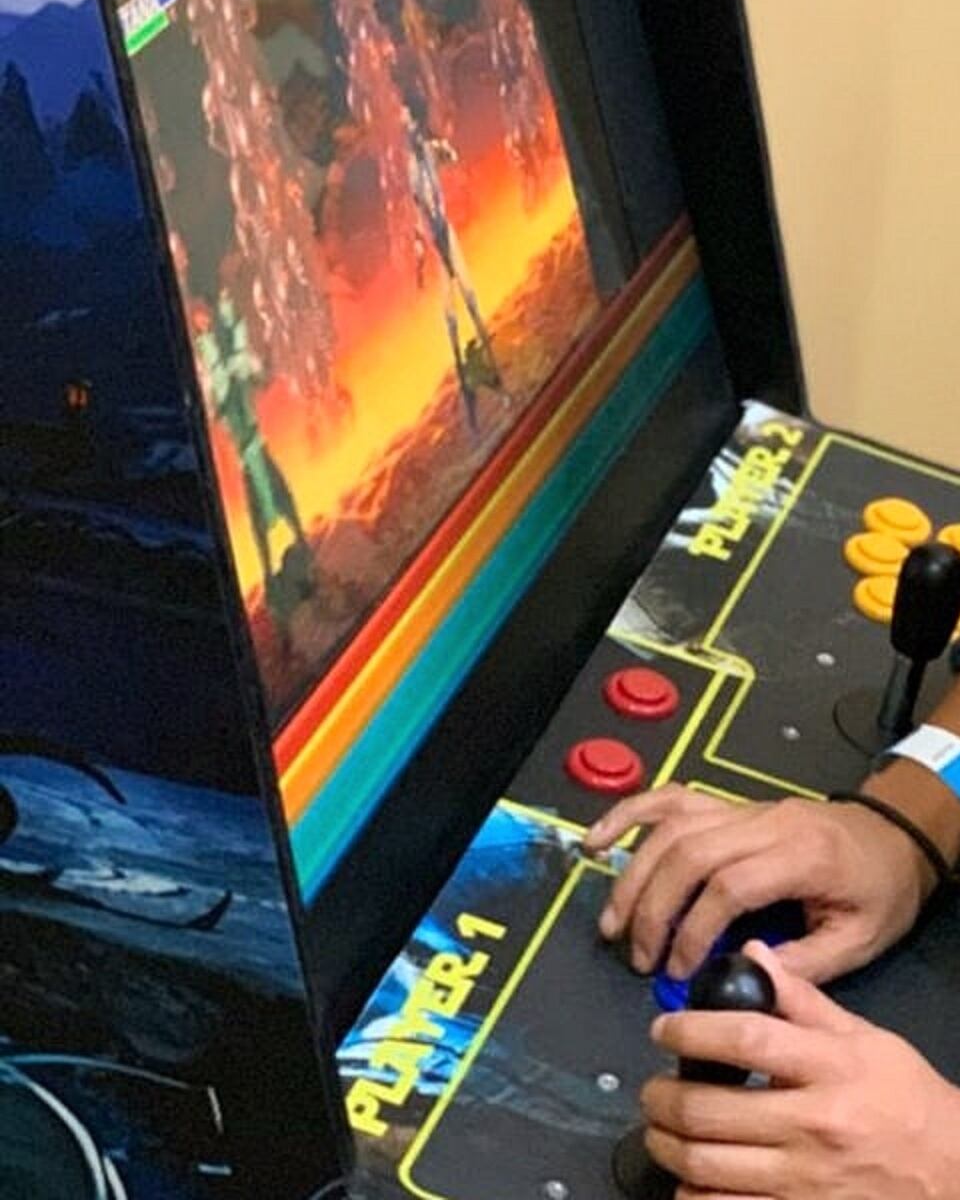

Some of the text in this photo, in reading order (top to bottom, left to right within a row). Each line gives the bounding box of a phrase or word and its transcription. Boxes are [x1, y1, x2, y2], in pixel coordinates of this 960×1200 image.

[688, 421, 804, 561] PLAYER 2
[345, 911, 507, 1138] PLAYER 1
